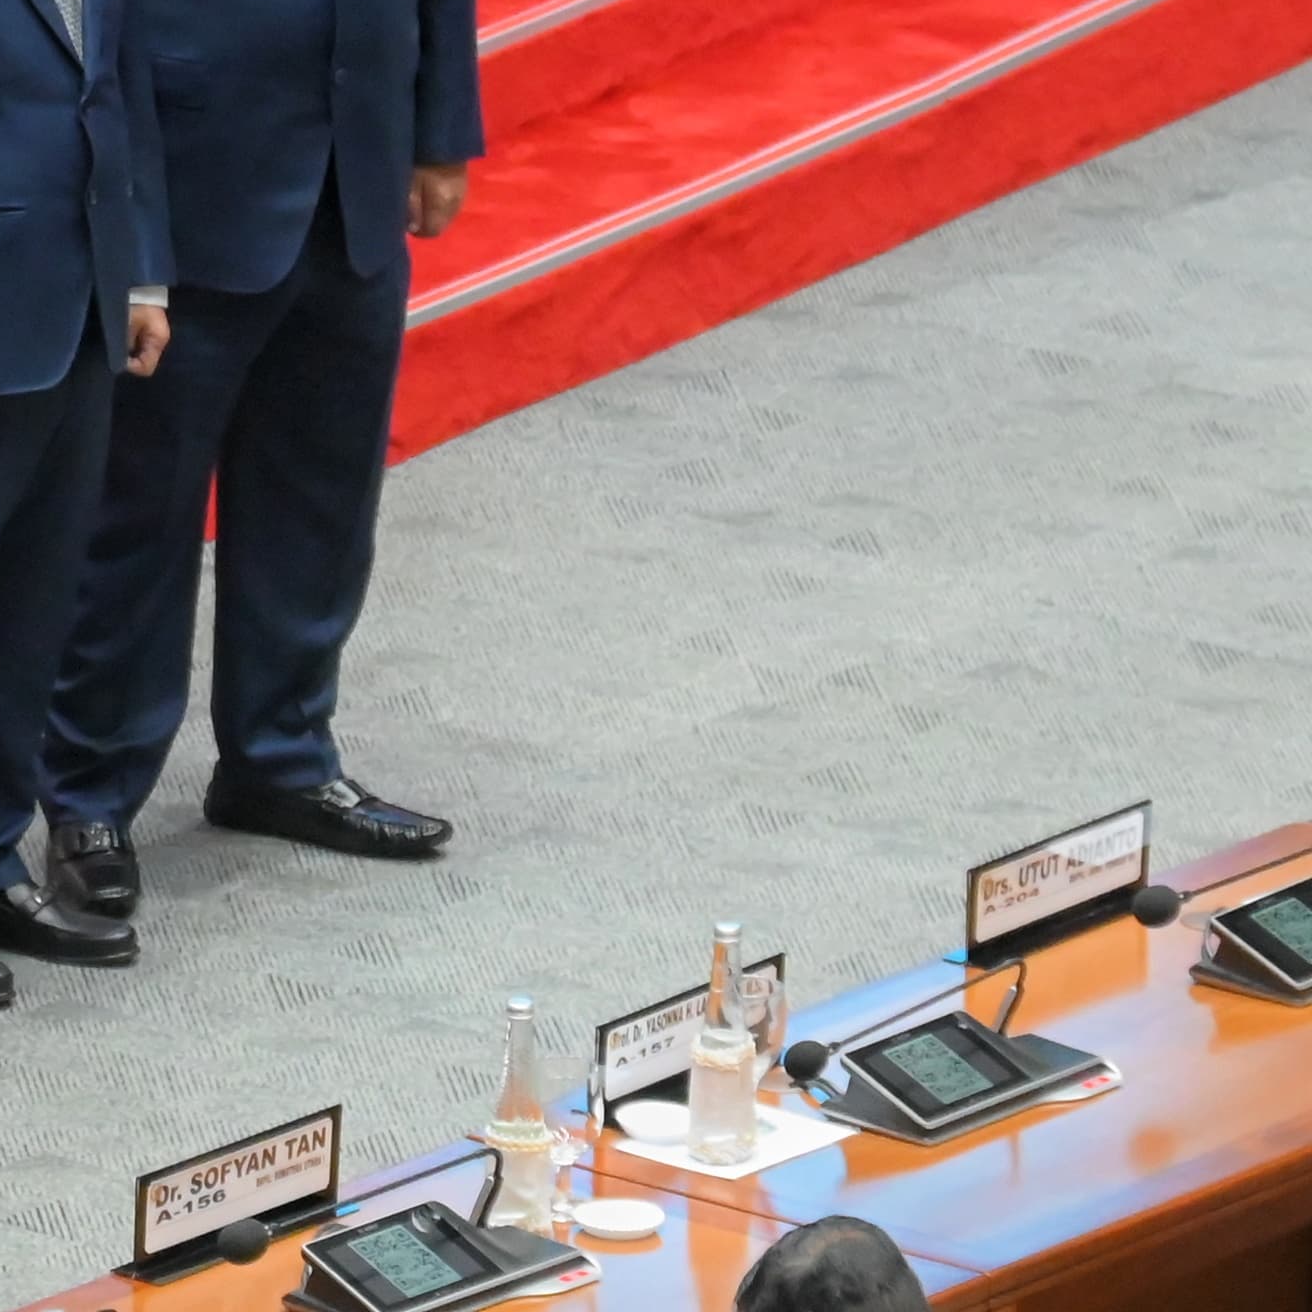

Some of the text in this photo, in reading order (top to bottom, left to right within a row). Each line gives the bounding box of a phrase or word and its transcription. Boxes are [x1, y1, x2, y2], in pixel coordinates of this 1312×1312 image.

[983, 873, 1014, 902] Drs.
[1018, 853, 1062, 887] UTUT
[616, 1035, 676, 1069] A-157
[155, 1183, 183, 1209] Dr.
[190, 1144, 278, 1195] SOFYAN
[284, 1126, 327, 1161] TAN
[156, 1188, 227, 1226] A-156
